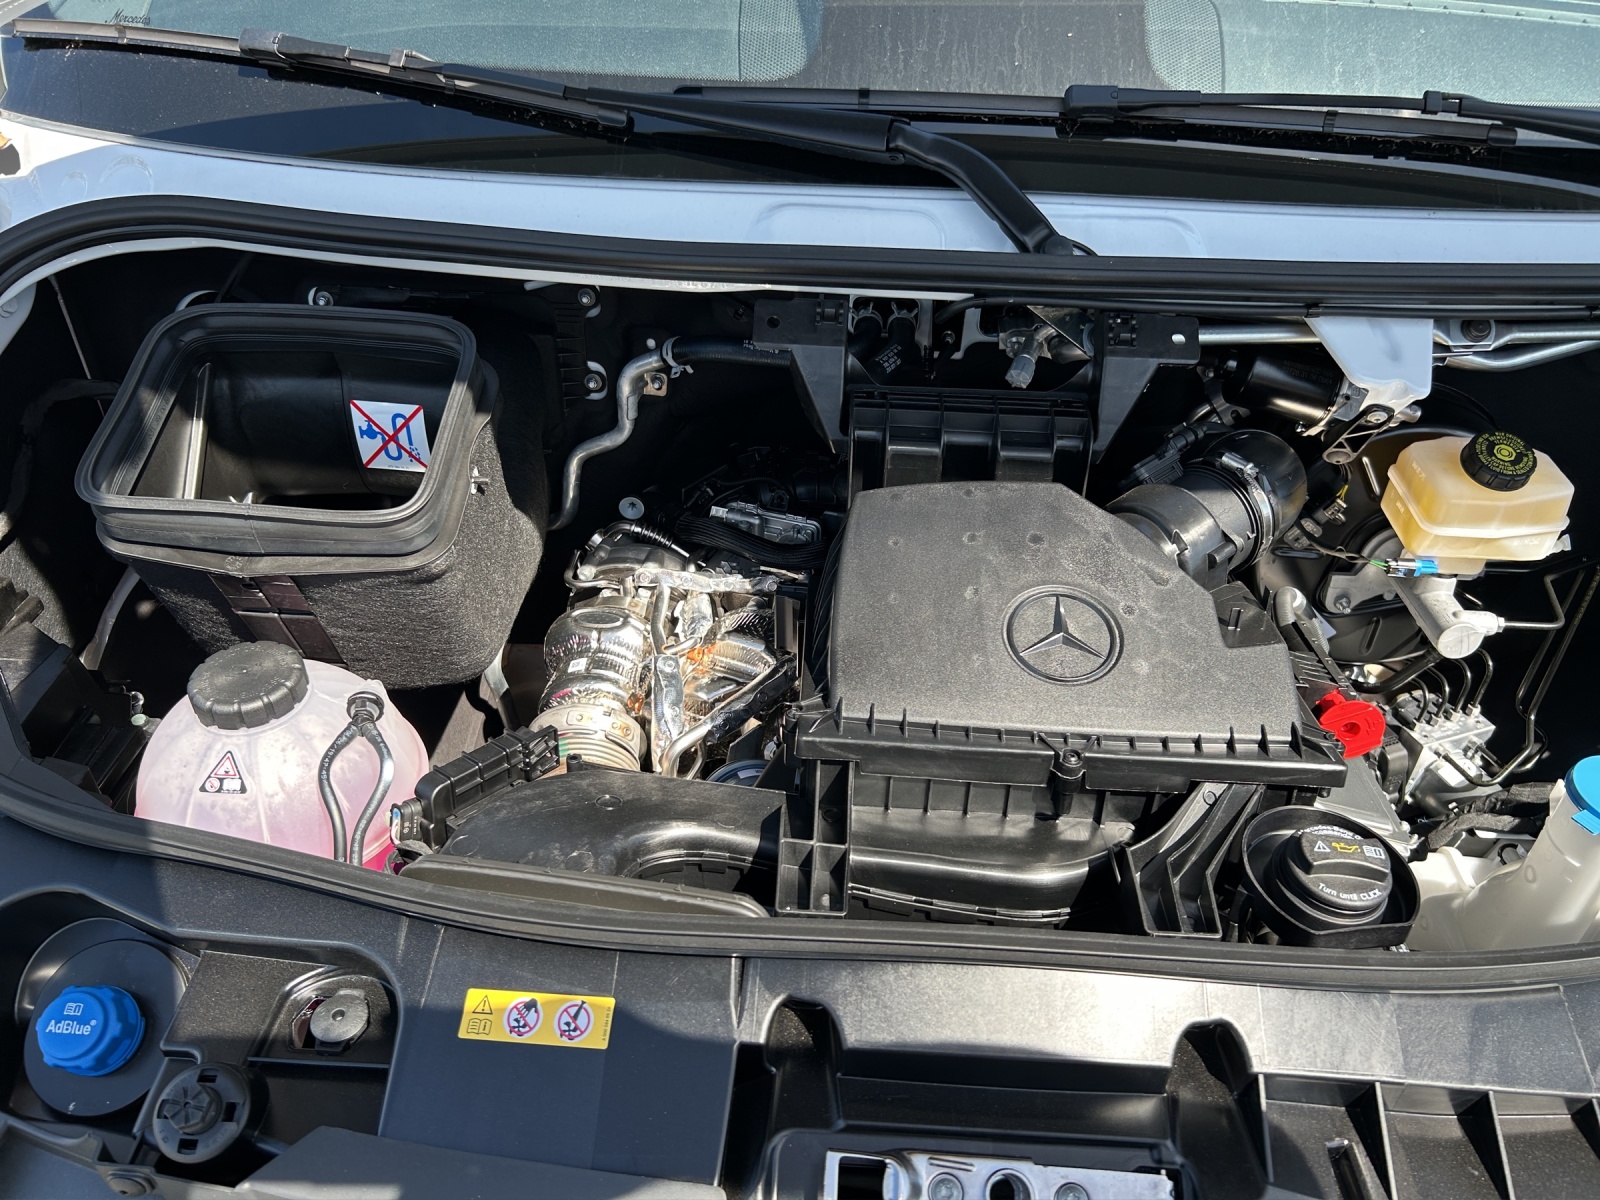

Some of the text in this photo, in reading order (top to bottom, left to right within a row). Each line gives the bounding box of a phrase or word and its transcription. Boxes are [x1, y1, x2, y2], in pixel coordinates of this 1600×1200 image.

[105, 8, 151, 26] Mercedes
[1319, 882, 1383, 900] Turn until CLICK
